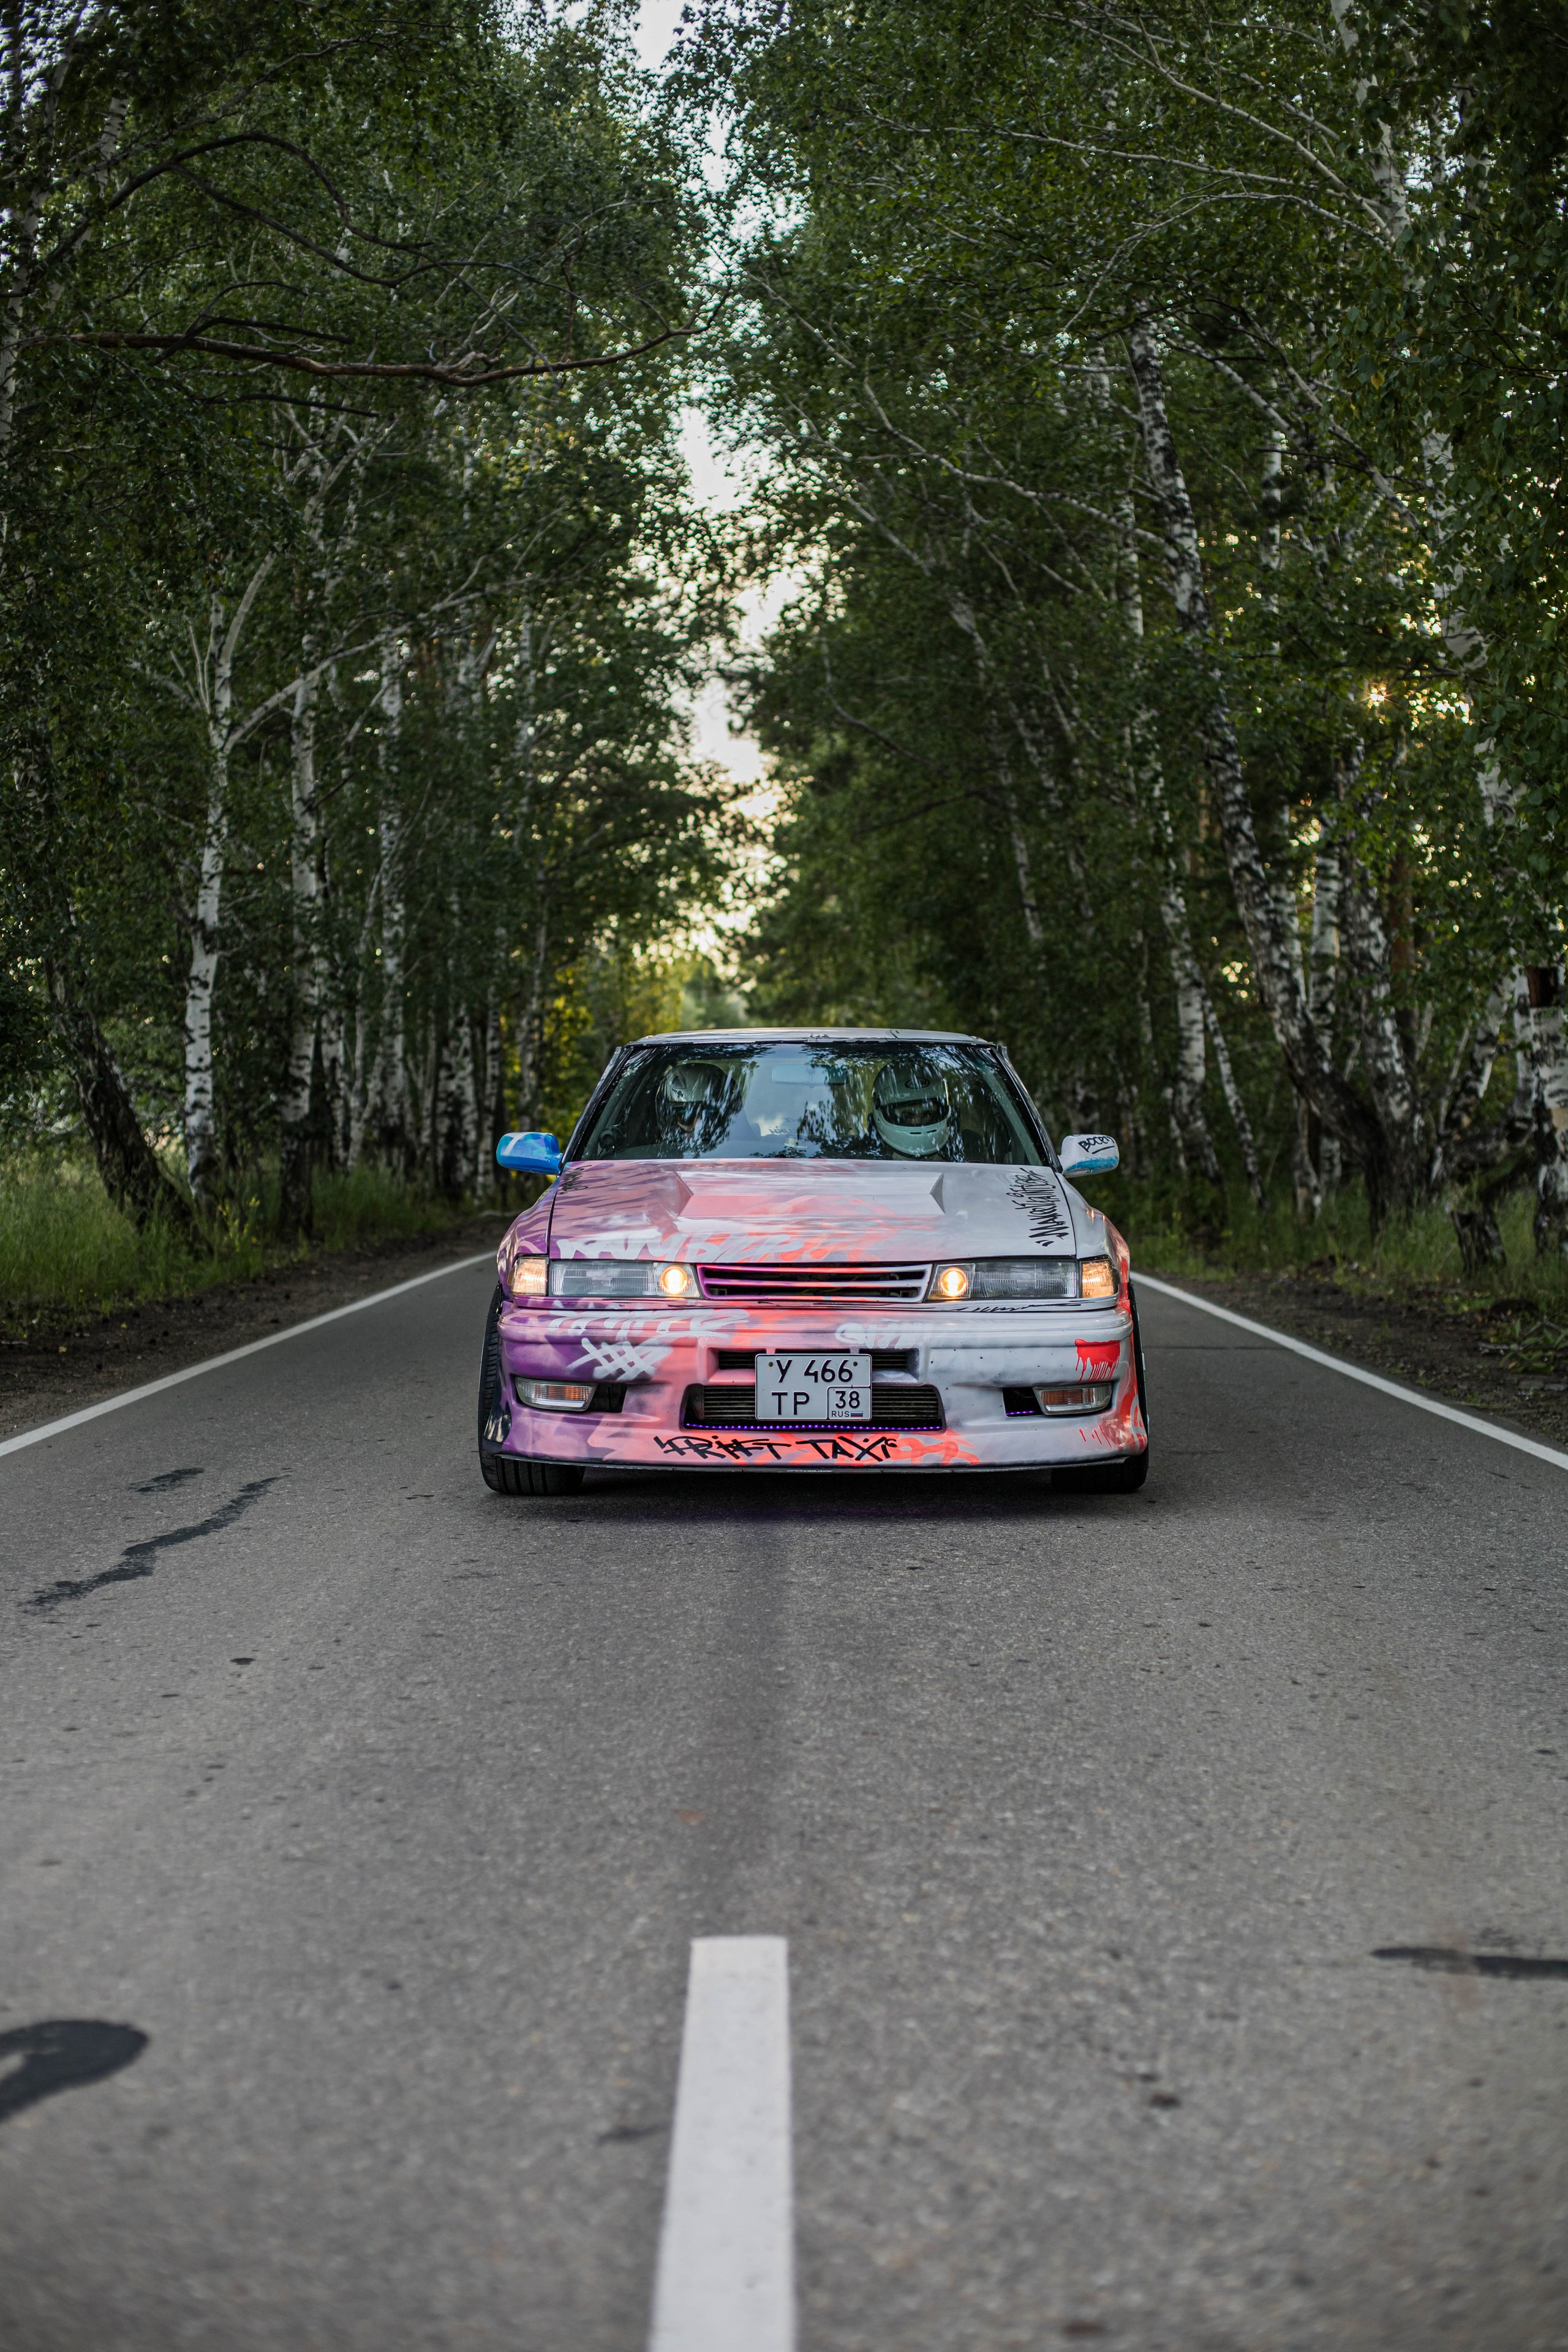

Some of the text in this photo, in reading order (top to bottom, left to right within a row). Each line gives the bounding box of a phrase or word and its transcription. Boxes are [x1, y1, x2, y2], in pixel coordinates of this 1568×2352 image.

[804, 1359, 853, 1383] 466
[771, 1391, 810, 1415] ТР
[835, 1390, 860, 1409] 38
